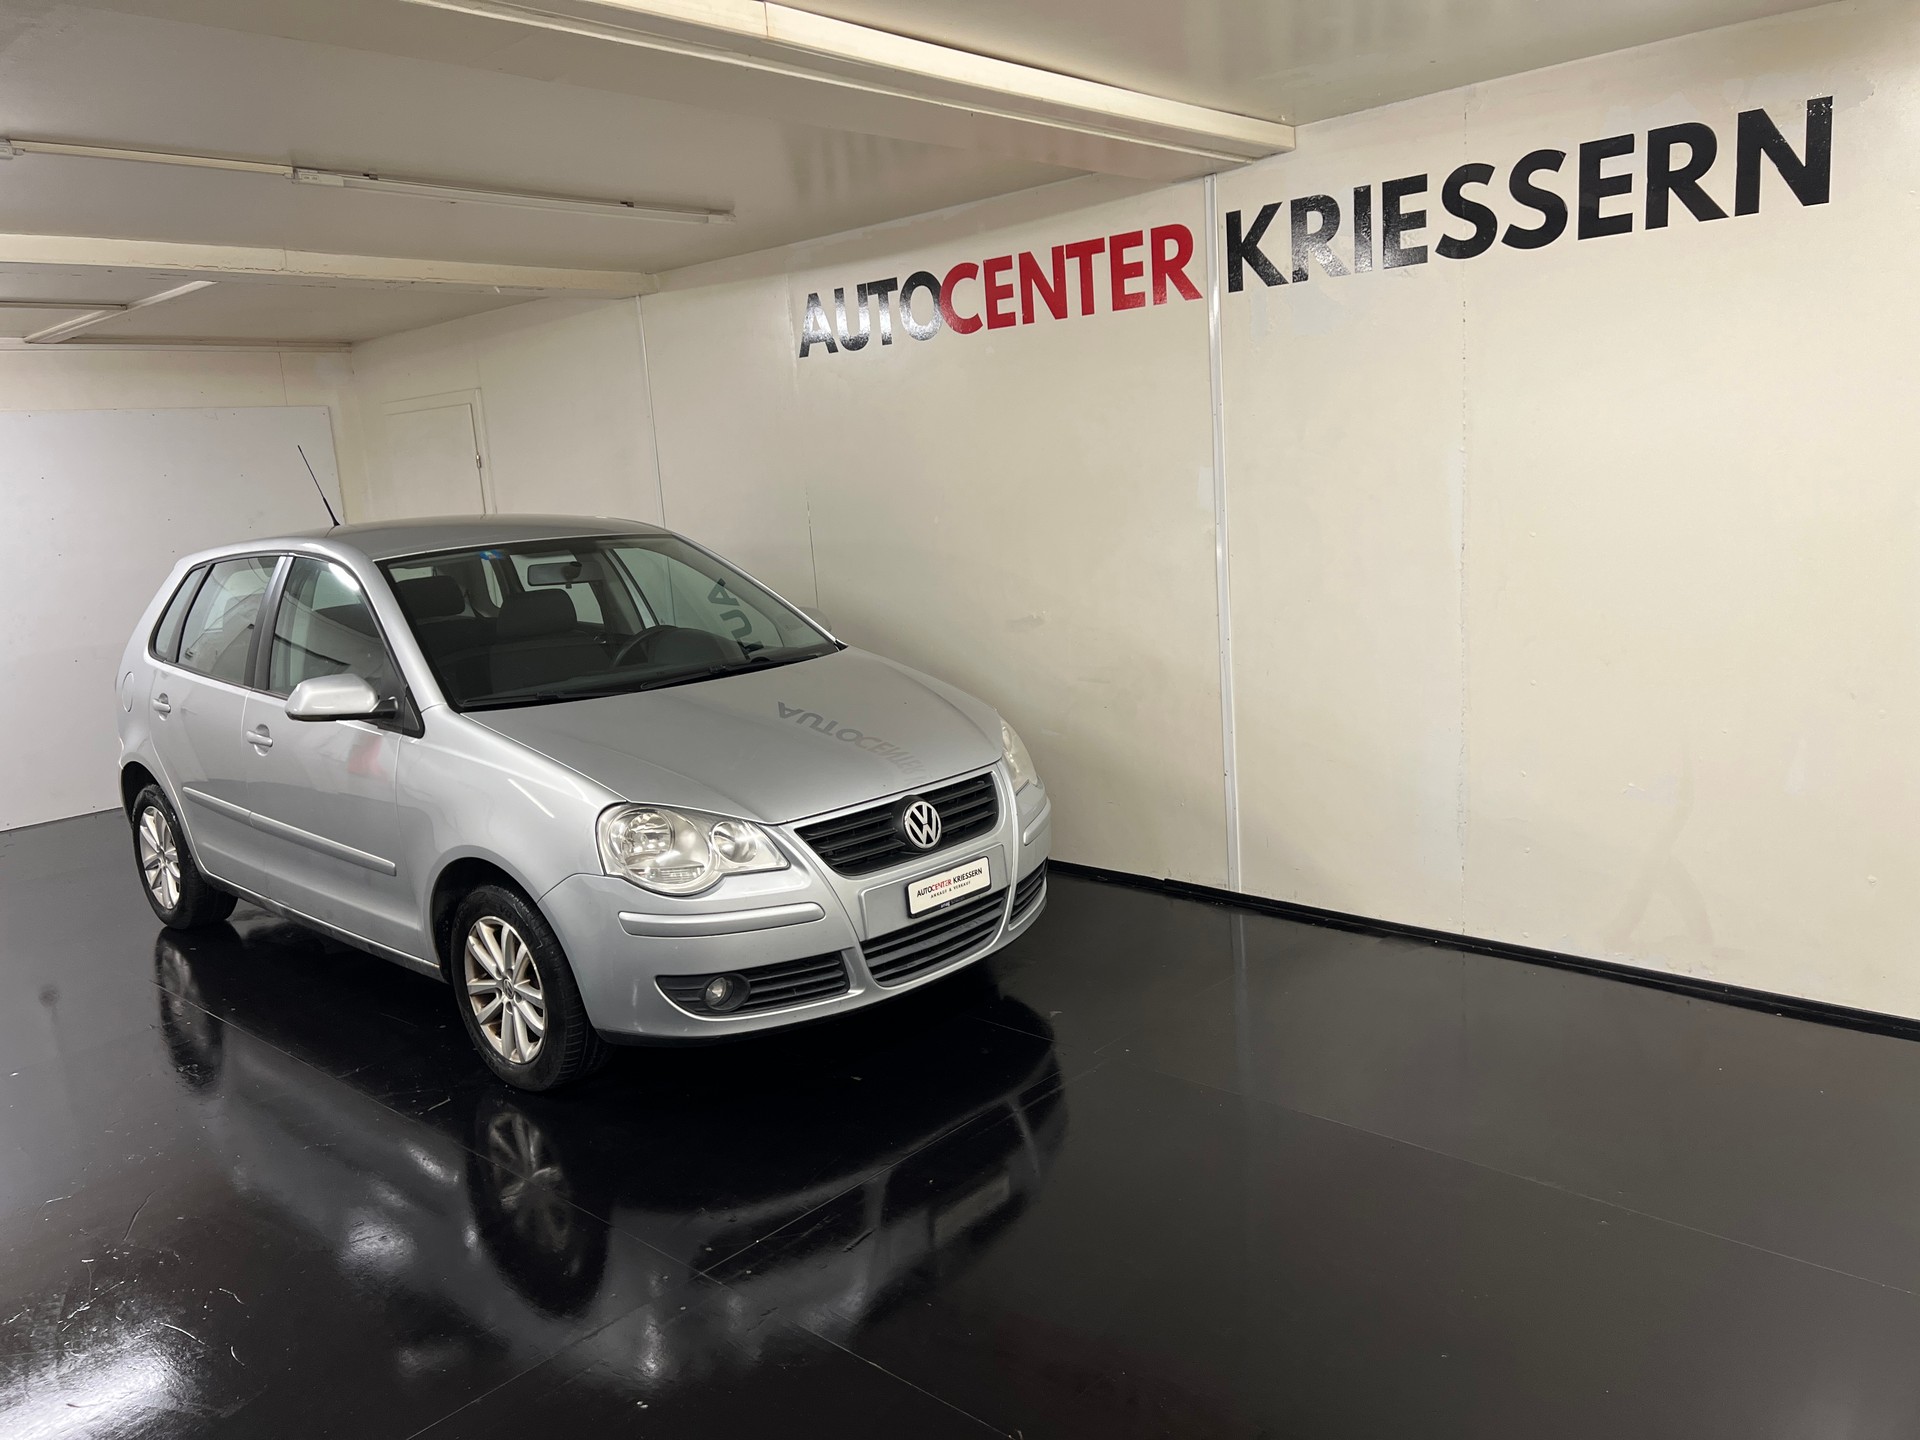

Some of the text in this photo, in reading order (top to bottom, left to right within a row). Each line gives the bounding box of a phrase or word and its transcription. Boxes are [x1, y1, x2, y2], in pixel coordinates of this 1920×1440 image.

[799, 95, 1833, 359] AUTOCENTER KRIESSERN
[904, 800, 941, 849] VW
[916, 867, 983, 897] AUTOCENTER KRIESSERN
